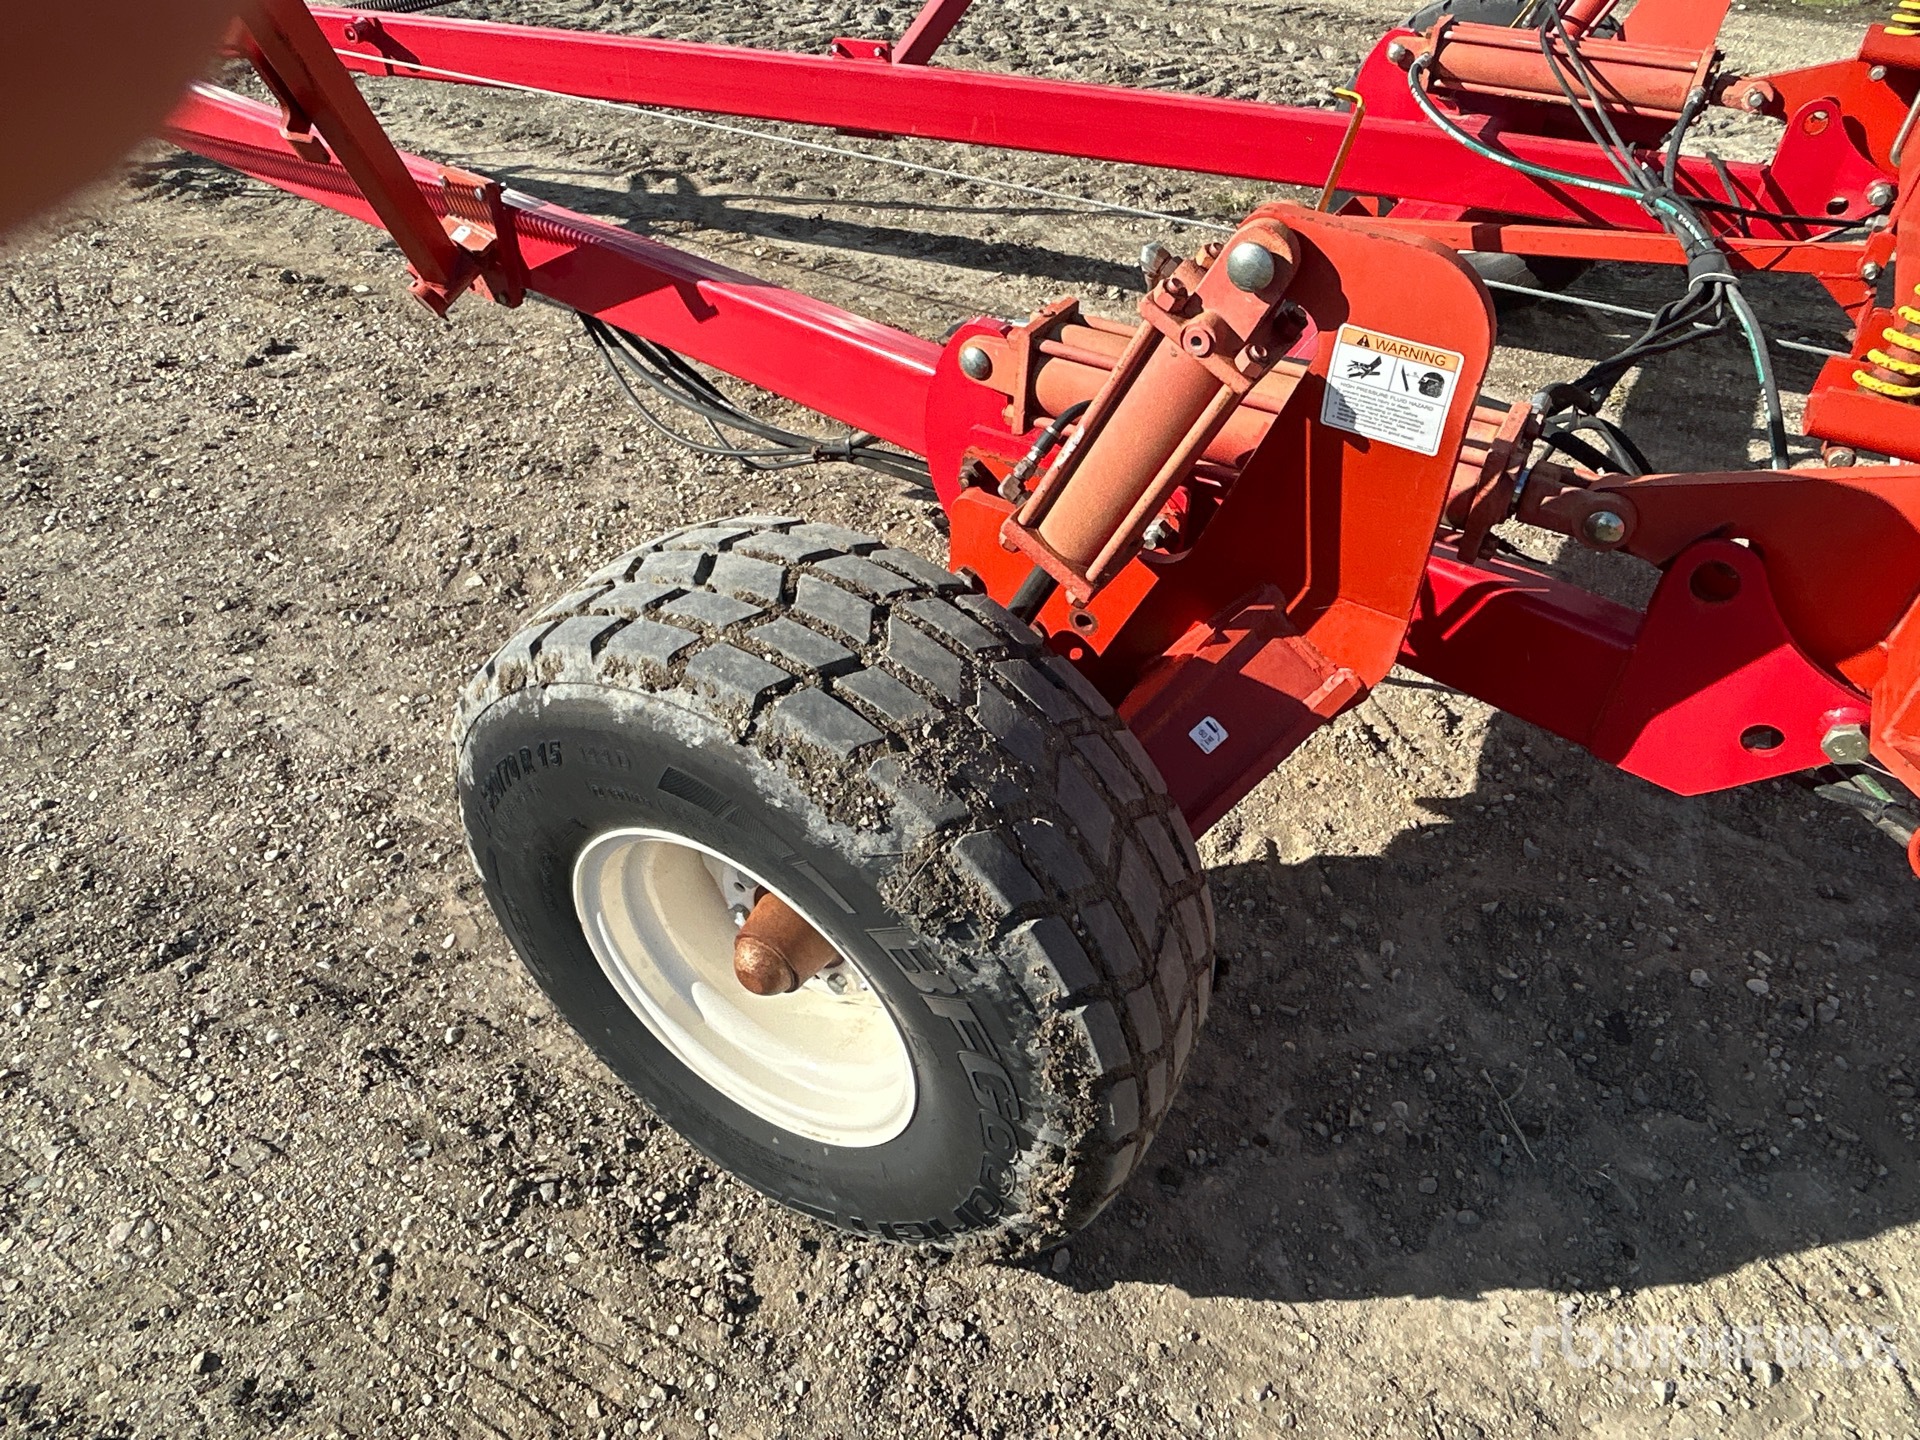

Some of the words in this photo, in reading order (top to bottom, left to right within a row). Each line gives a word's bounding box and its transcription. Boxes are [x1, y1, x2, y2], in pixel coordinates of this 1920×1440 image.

[1375, 338, 1446, 367] WARNING
[1356, 386, 1388, 399] PRESSURE
[1389, 395, 1407, 404] FLUID
[1408, 400, 1434, 412] HAZARD
[519, 745, 536, 775] R
[537, 739, 563, 769] 15
